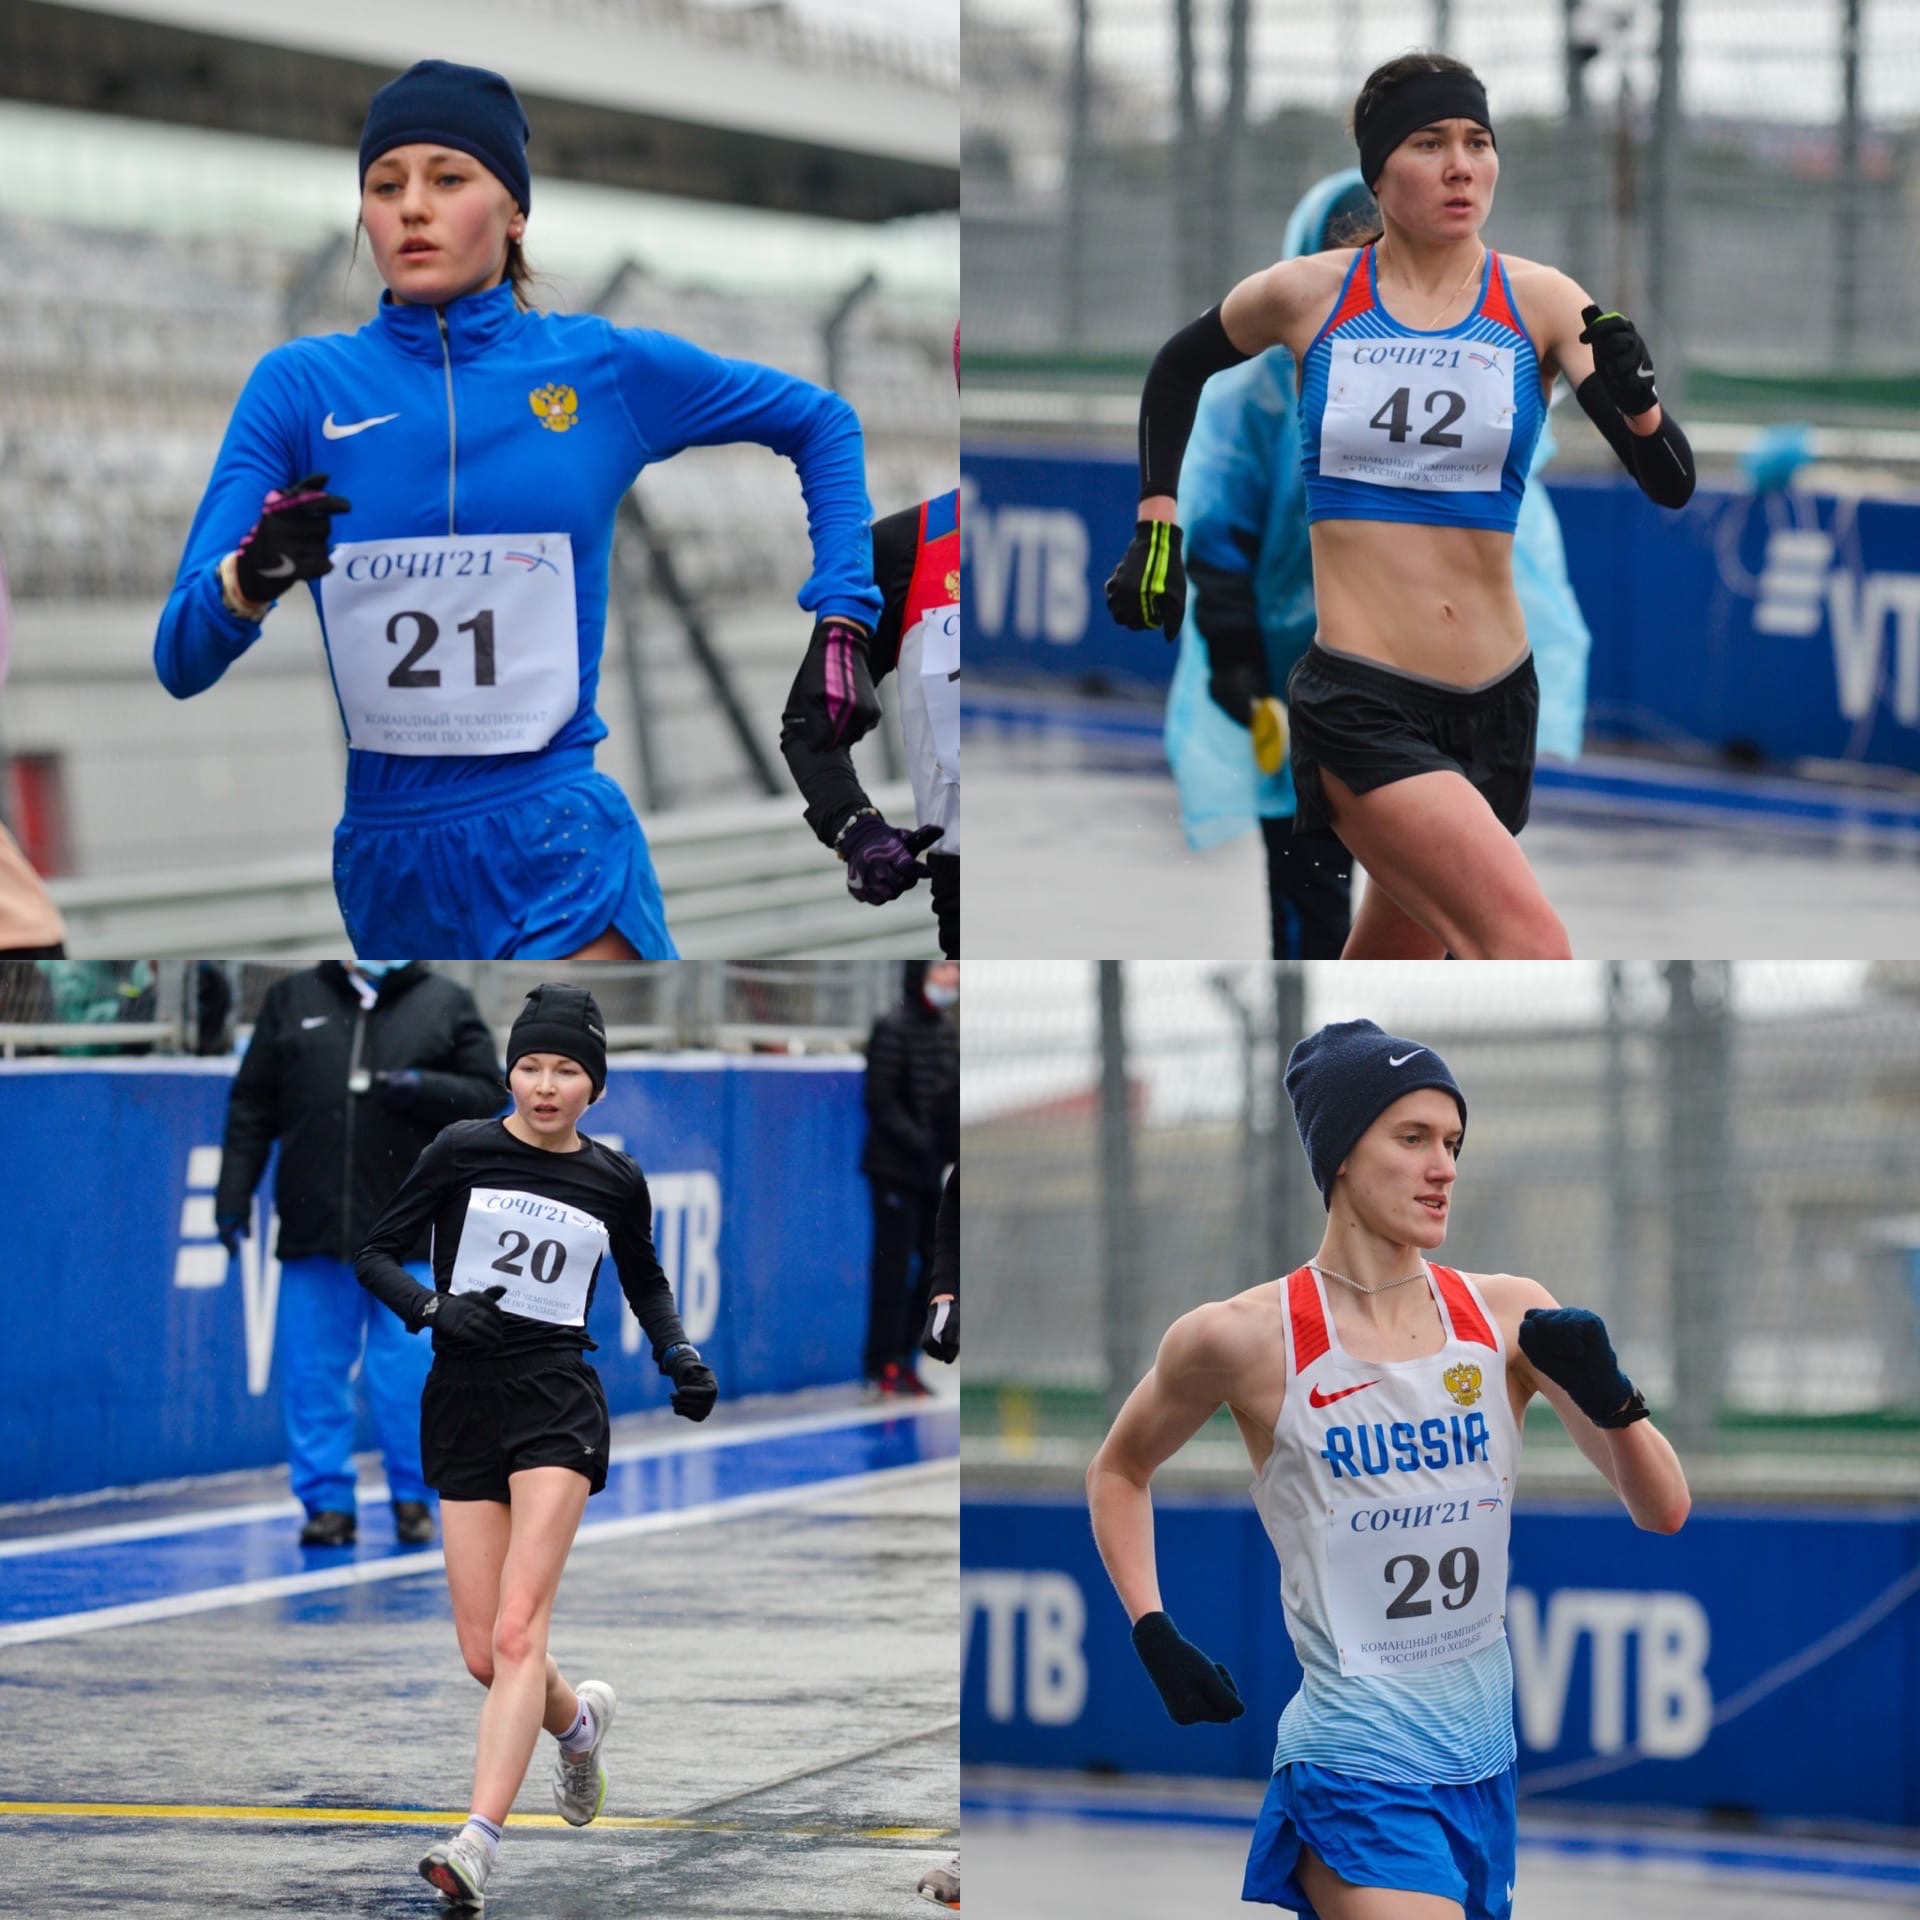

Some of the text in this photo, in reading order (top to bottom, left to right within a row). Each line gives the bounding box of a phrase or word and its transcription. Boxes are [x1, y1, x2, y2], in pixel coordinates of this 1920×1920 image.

[1369, 386, 1466, 448] 42
[1343, 454, 1415, 470] КОМАНДНЫЙ
[1358, 463, 1464, 483] РОССИИ ПО ХОДЬБЕ
[972, 507, 1091, 644] VTB
[386, 609, 496, 688] 21
[364, 710, 547, 728] КОМАНДНЫЙ ЧЕМПИОНАТ
[383, 728, 526, 743] РОССИИ ПО ХОДЬБЕ
[491, 1230, 567, 1284] 20
[618, 1170, 722, 1355] TB
[512, 1299, 525, 1309] ПО
[1321, 1411, 1489, 1478] RUSSIA
[1384, 1546, 1480, 1620] 29
[1361, 1613, 1493, 1653] КОМАНДНЫЙ ЧЕМПИОНАТ
[1380, 1632, 1482, 1665] РОССИИ ПО ХОДЬБЕ
[1508, 1586, 1713, 1760] VTB
